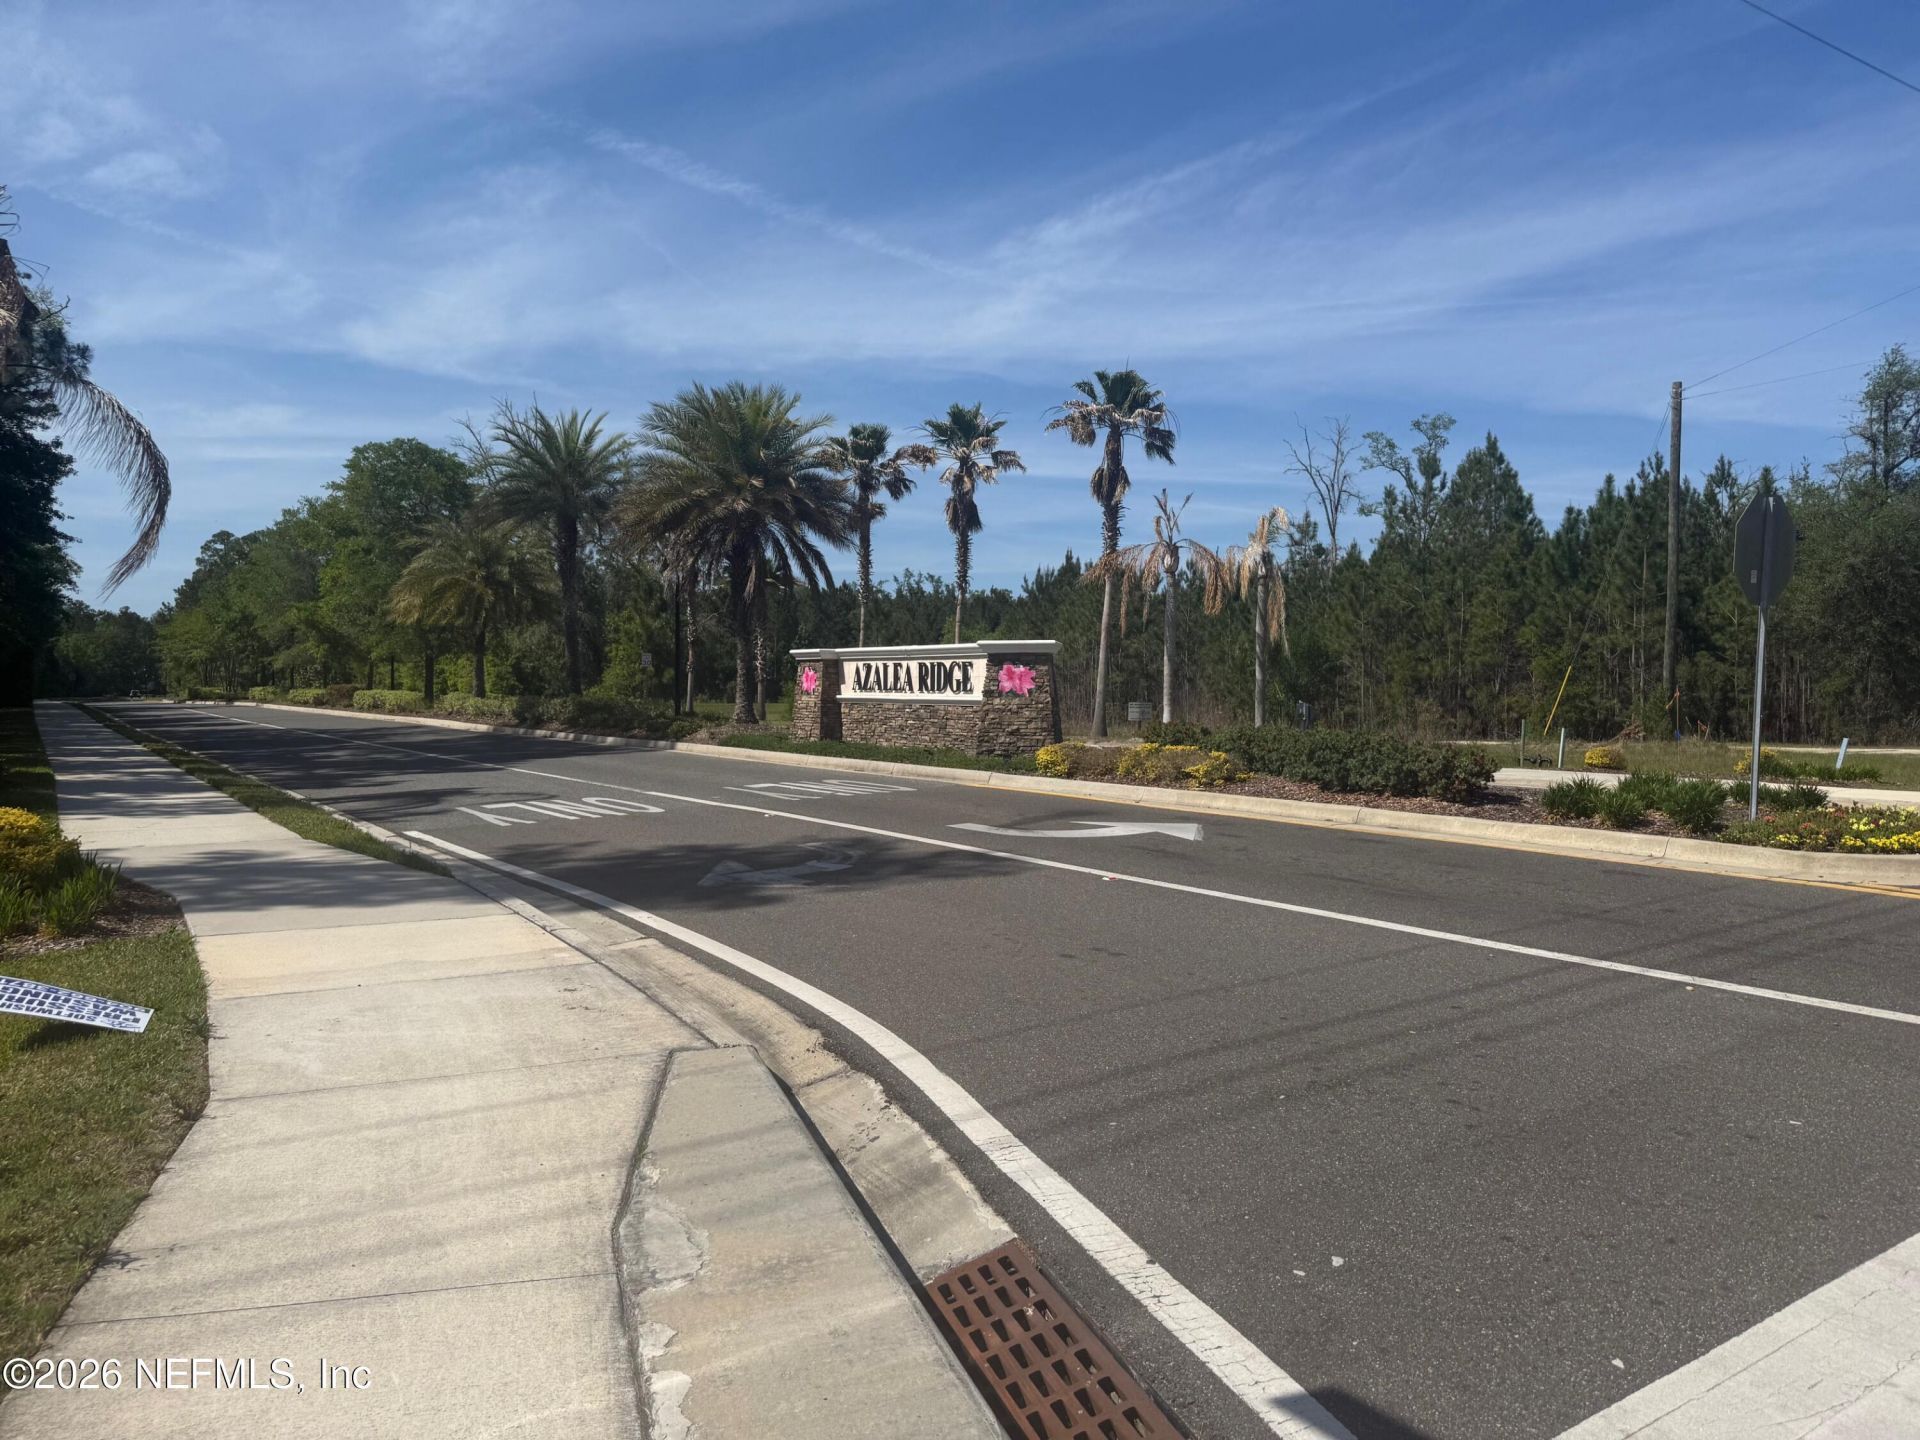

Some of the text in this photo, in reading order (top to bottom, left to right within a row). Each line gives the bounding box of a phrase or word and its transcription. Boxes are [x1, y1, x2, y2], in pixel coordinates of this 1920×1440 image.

[852, 661, 974, 694] AZALEA RIDGE
[723, 779, 917, 801] ONLY
[456, 797, 665, 826] ONLY
[1, 985, 136, 1016] WASHING
